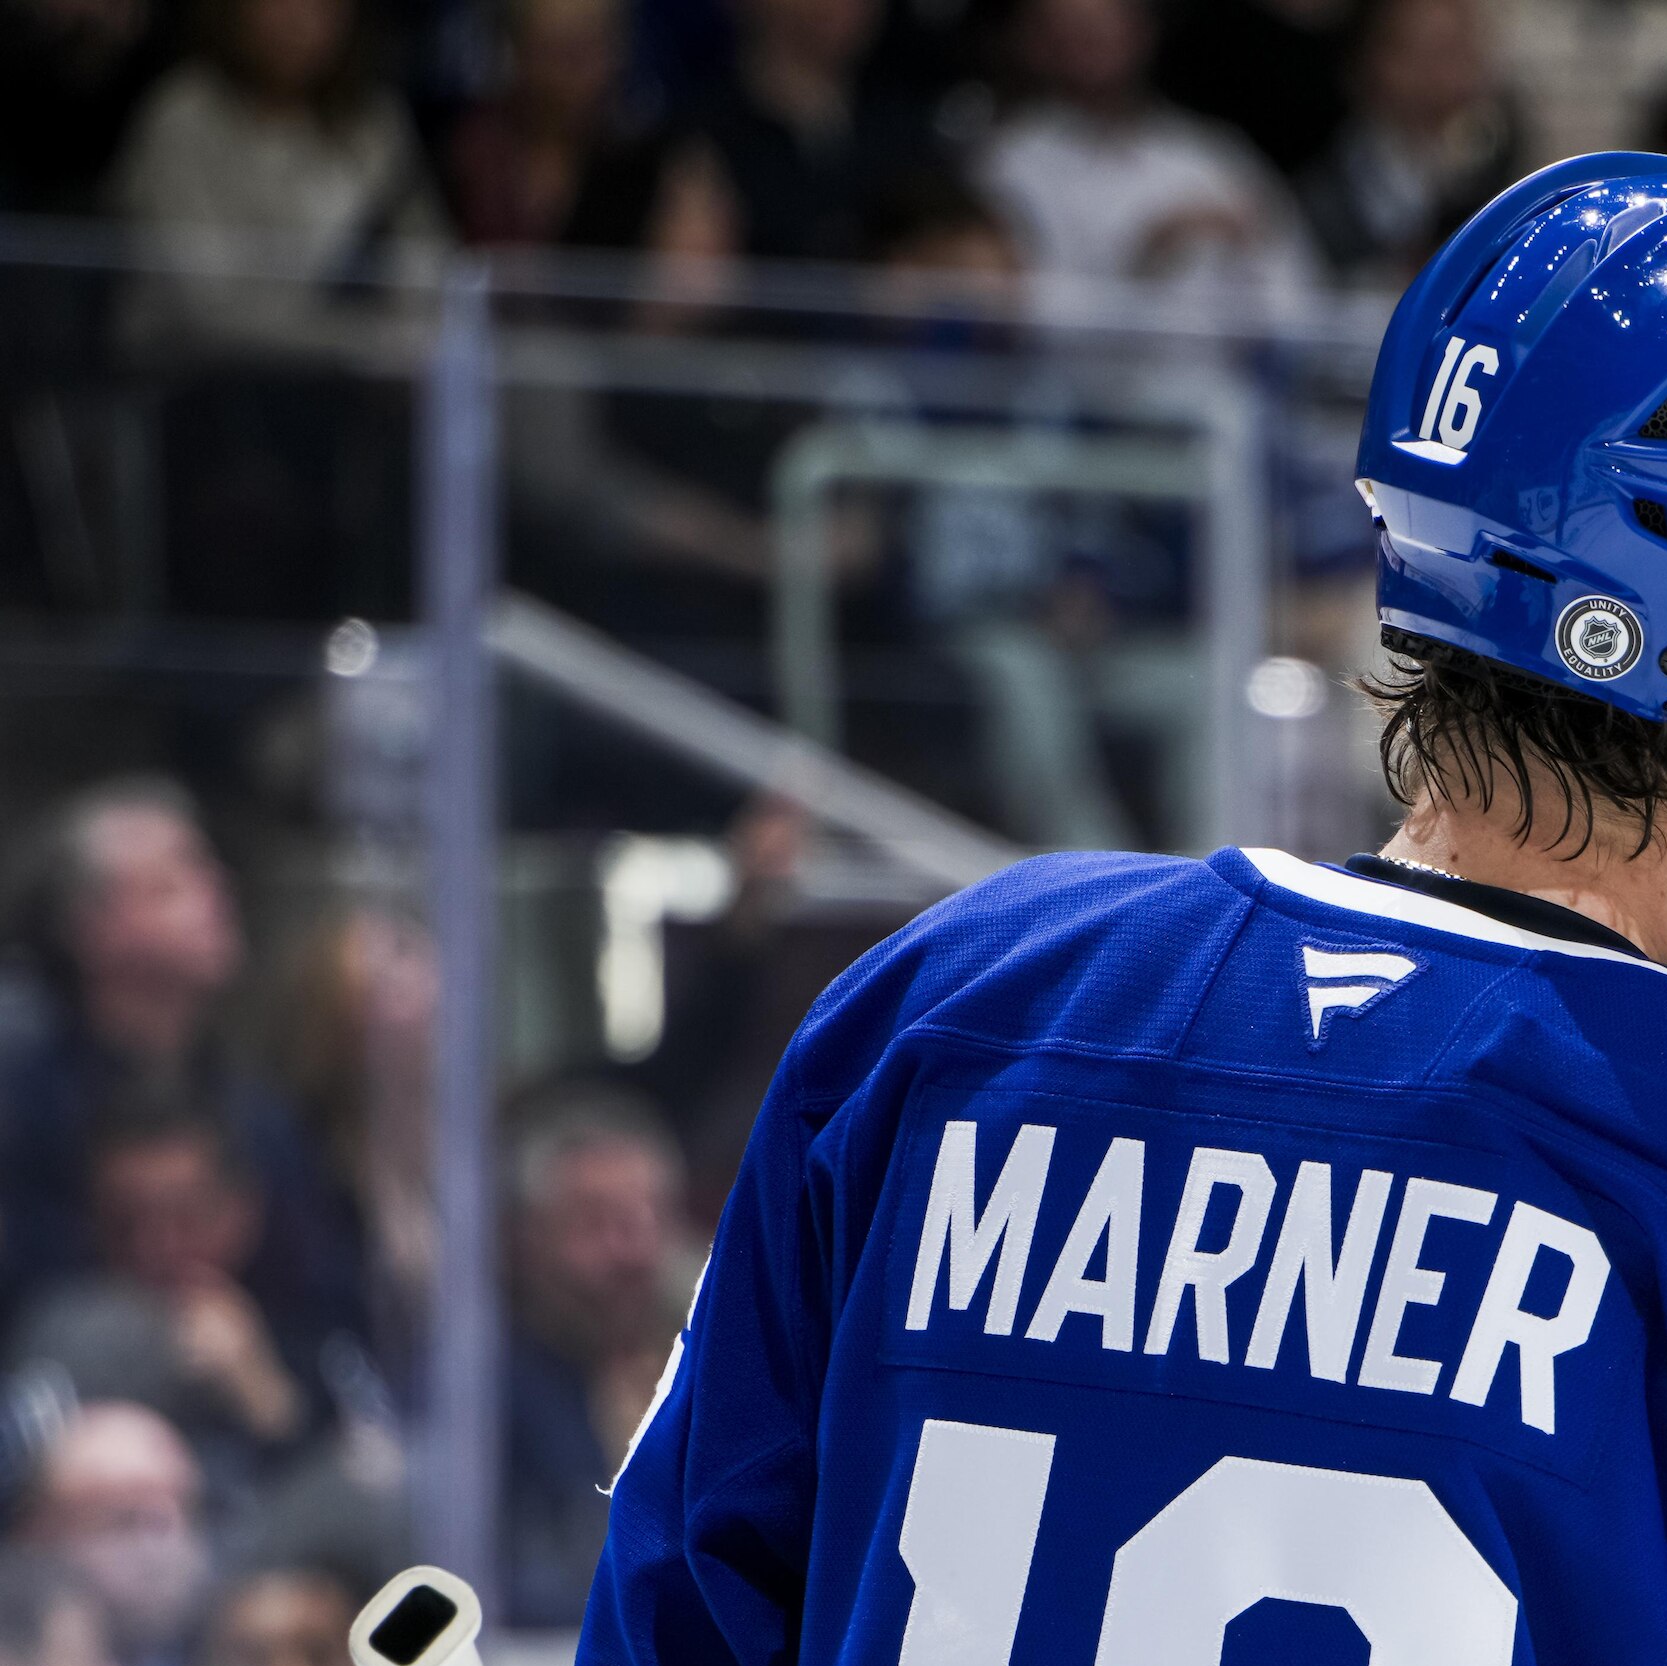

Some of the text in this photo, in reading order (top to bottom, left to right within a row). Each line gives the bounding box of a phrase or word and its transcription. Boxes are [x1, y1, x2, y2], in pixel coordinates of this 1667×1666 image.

[1418, 335, 1499, 450] 16
[1588, 600, 1627, 618] UNITY
[1587, 632, 1612, 647] NHL
[1563, 647, 1623, 677] EQUALITY
[905, 1120, 1612, 1435] MARNER
